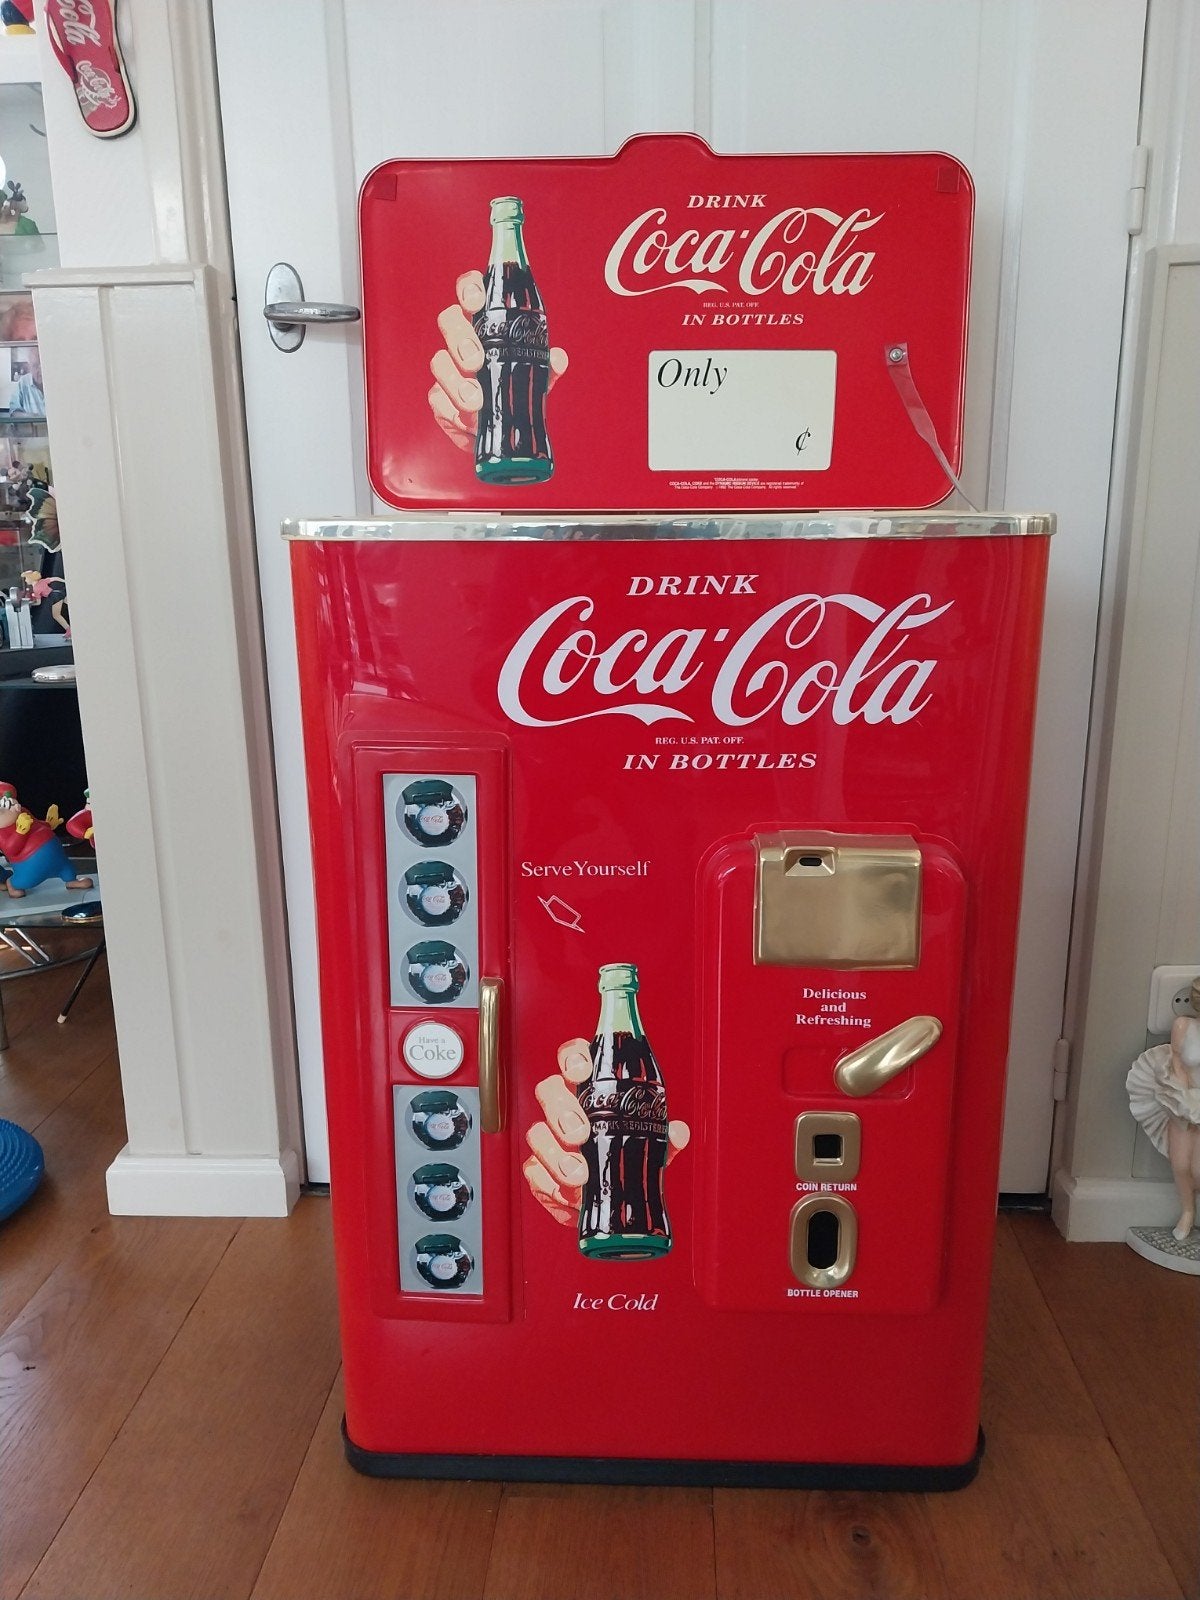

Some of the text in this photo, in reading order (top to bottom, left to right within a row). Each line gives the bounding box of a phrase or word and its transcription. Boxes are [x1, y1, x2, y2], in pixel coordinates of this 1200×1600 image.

[687, 194, 767, 209] DRINK
[604, 207, 886, 297] Coca-Cola
[681, 313, 804, 326] IN BOTTLES
[657, 357, 728, 395] Only
[626, 574, 759, 596] DRINK
[497, 593, 955, 727] Coca-Cola
[655, 736, 745, 745] REG. U.S. PAT. OFF.
[623, 753, 817, 770] IN BOTTLES
[521, 860, 651, 877] Serve Yourself
[802, 987, 867, 1000] Delicious
[820, 1002, 847, 1013] and
[795, 1013, 872, 1029] Refreshing
[409, 1044, 456, 1061] Coke
[795, 1182, 858, 1192] COIN RETURN
[787, 1288, 859, 1298] BOTTLE OPENER
[573, 1292, 659, 1311] Ice Cold
